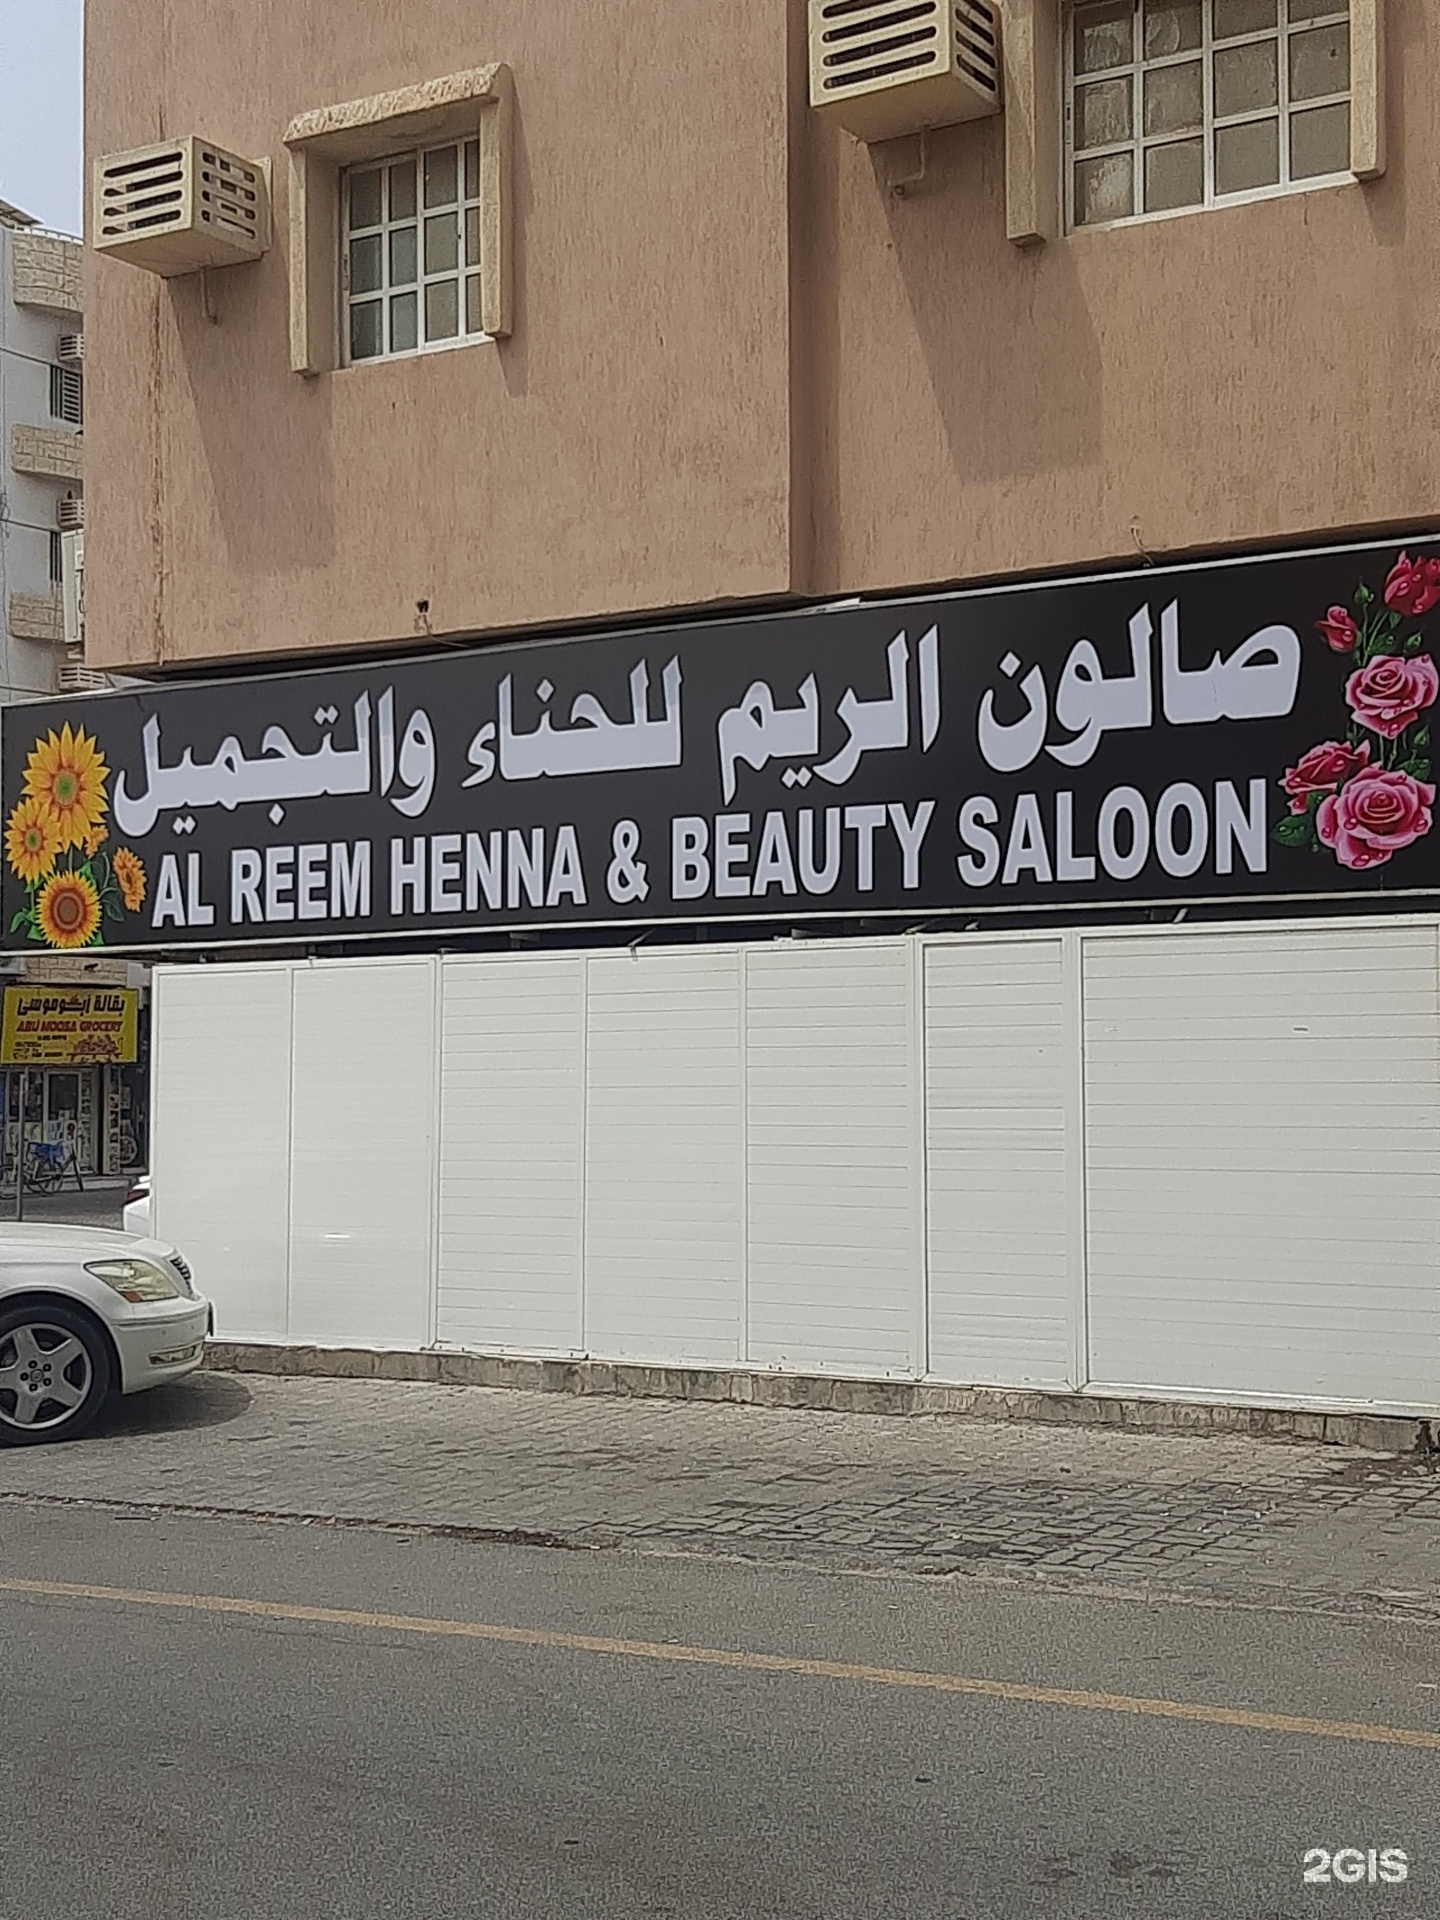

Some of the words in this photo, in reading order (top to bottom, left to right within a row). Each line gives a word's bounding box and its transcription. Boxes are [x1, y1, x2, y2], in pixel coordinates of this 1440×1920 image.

[112, 685, 437, 836] والتجميل
[460, 654, 682, 789] للحناء
[716, 623, 940, 807] الريم
[978, 598, 1302, 774] صالون
[150, 852, 215, 928] AL
[230, 840, 372, 924] REEM
[390, 825, 588, 914] HENNA
[606, 819, 651, 905] &
[671, 800, 936, 901] BEAUTY
[957, 778, 1269, 888] SALOON
[16, 1020, 40, 1032] ABU
[41, 1020, 77, 1032] MOOSA
[79, 1020, 124, 1032] GROCERY
